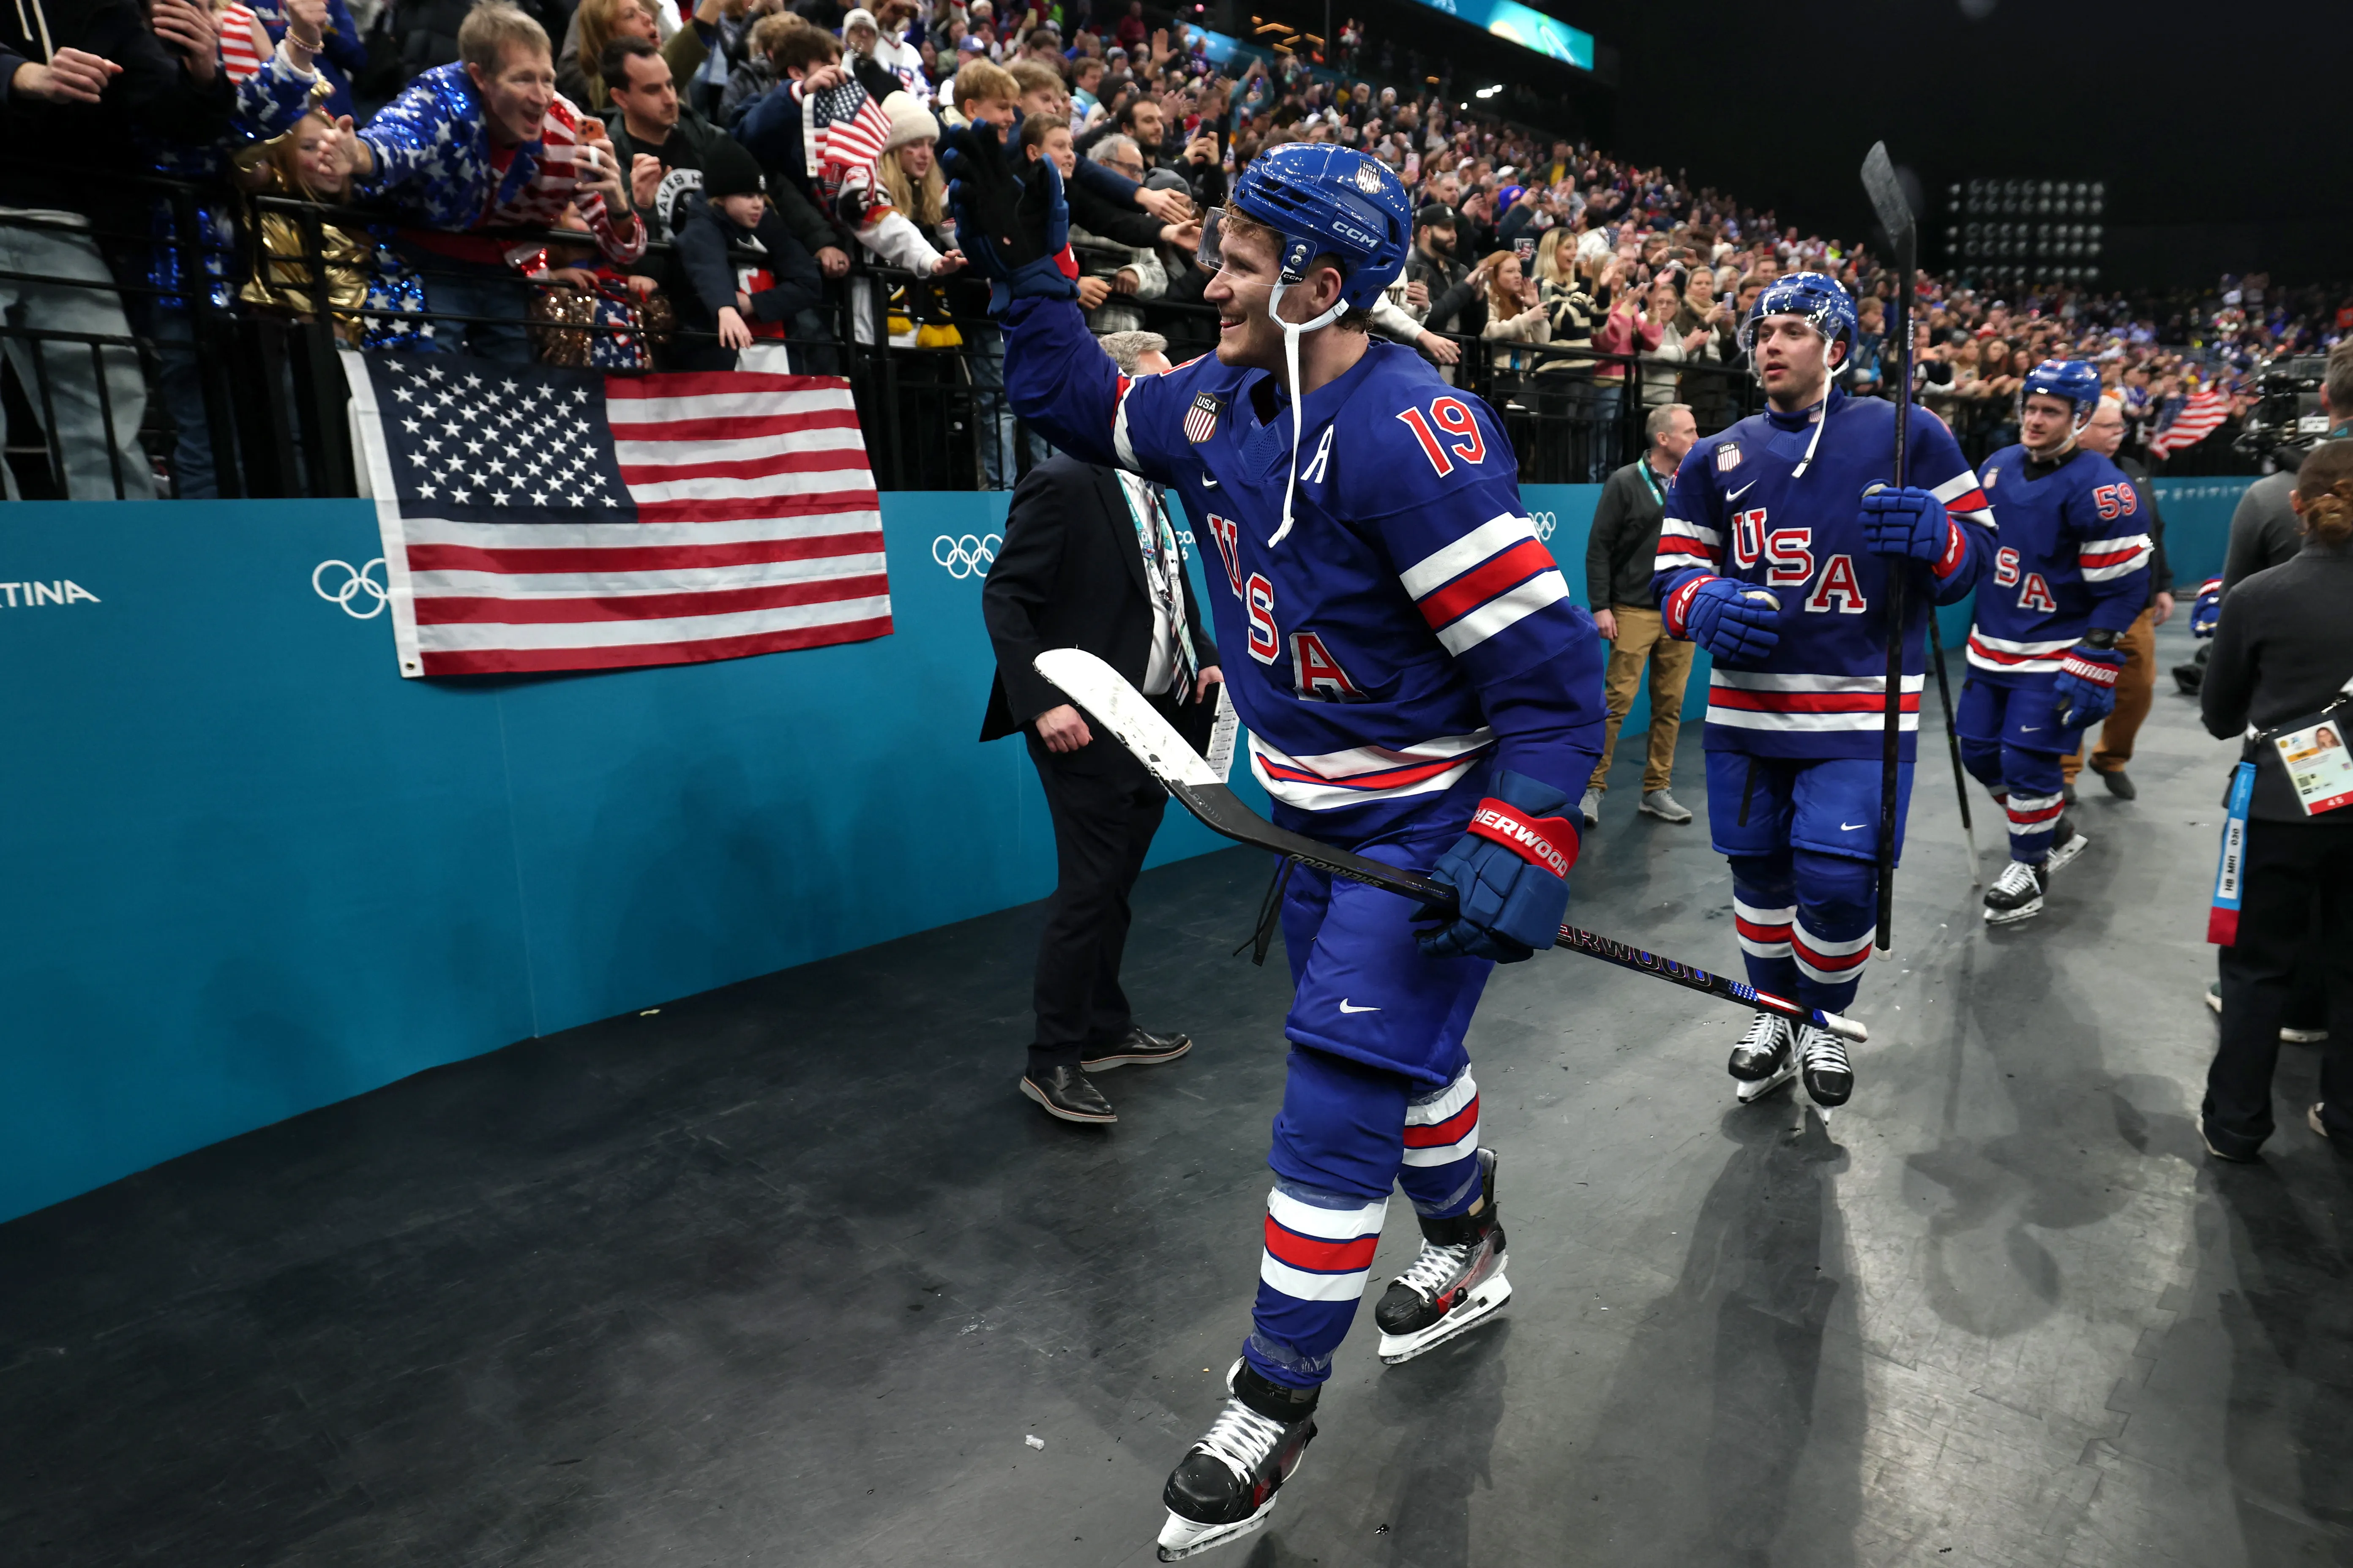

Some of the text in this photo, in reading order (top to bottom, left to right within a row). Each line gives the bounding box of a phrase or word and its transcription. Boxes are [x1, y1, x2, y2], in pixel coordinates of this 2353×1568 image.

[1363, 162, 1377, 174] USA
[1332, 221, 1378, 248] CCM
[1197, 396, 1216, 412] USA
[1300, 424, 1334, 483] A
[1396, 396, 1486, 478] 19
[1719, 443, 1735, 453] USA
[1128, 503, 1137, 518] Allianz
[2092, 482, 2137, 521] 59
[1731, 507, 1867, 614] USA
[1993, 546, 2057, 613] SA
[1207, 513, 1370, 703] USA
[1472, 809, 1568, 876] HERWOOD
[1288, 853, 1384, 888] SHERWOOD
[1556, 925, 1711, 987] ERWOOD
